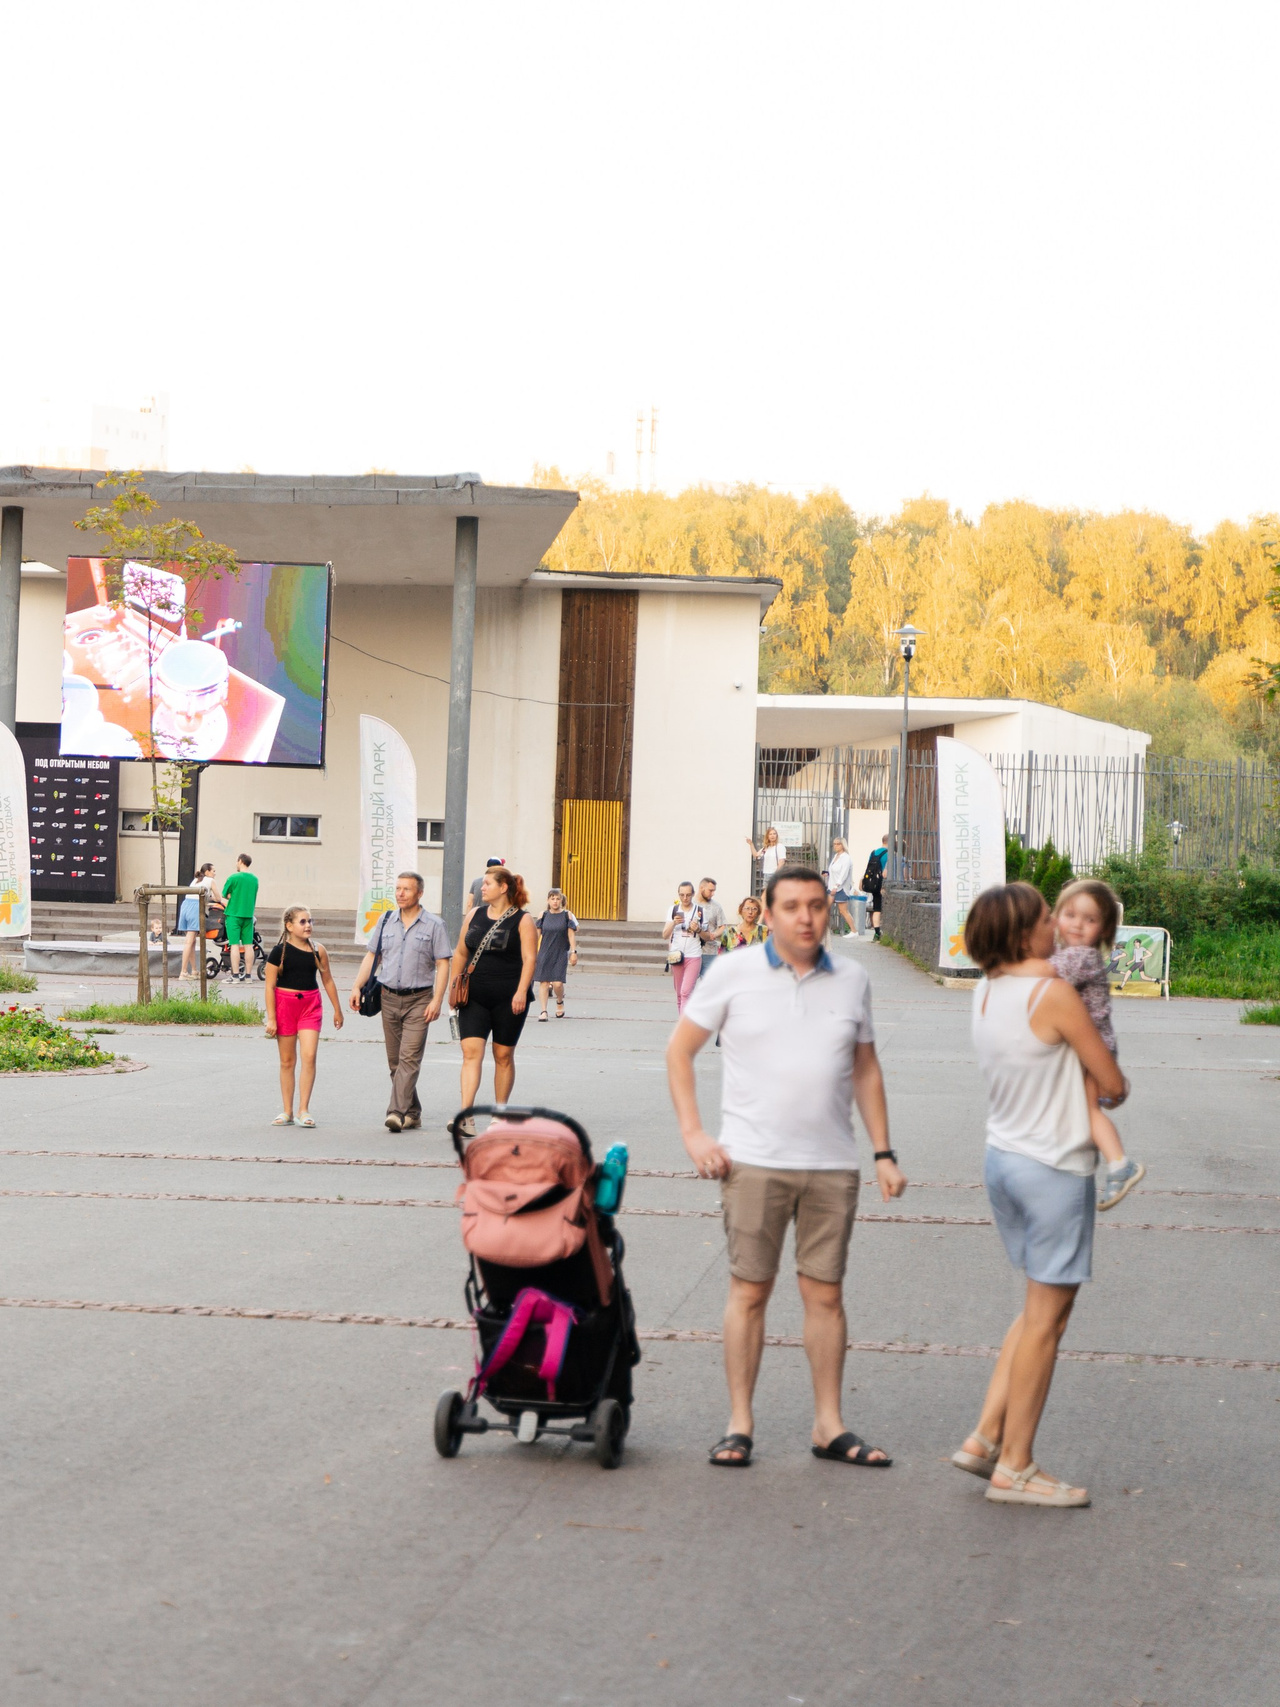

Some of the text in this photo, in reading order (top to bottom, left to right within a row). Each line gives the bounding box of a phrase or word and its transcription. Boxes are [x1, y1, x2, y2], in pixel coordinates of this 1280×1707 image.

[34, 758, 110, 769] ПОД ОТКРЫТЫМ НЕБОМ
[955, 762, 969, 807] ПАРК
[3, 796, 13, 839] ОТДЫХА
[369, 741, 386, 912] ЦЕНТРАЛЬНЫЙ ПАРК
[385, 804, 395, 848] ОТДЫХА
